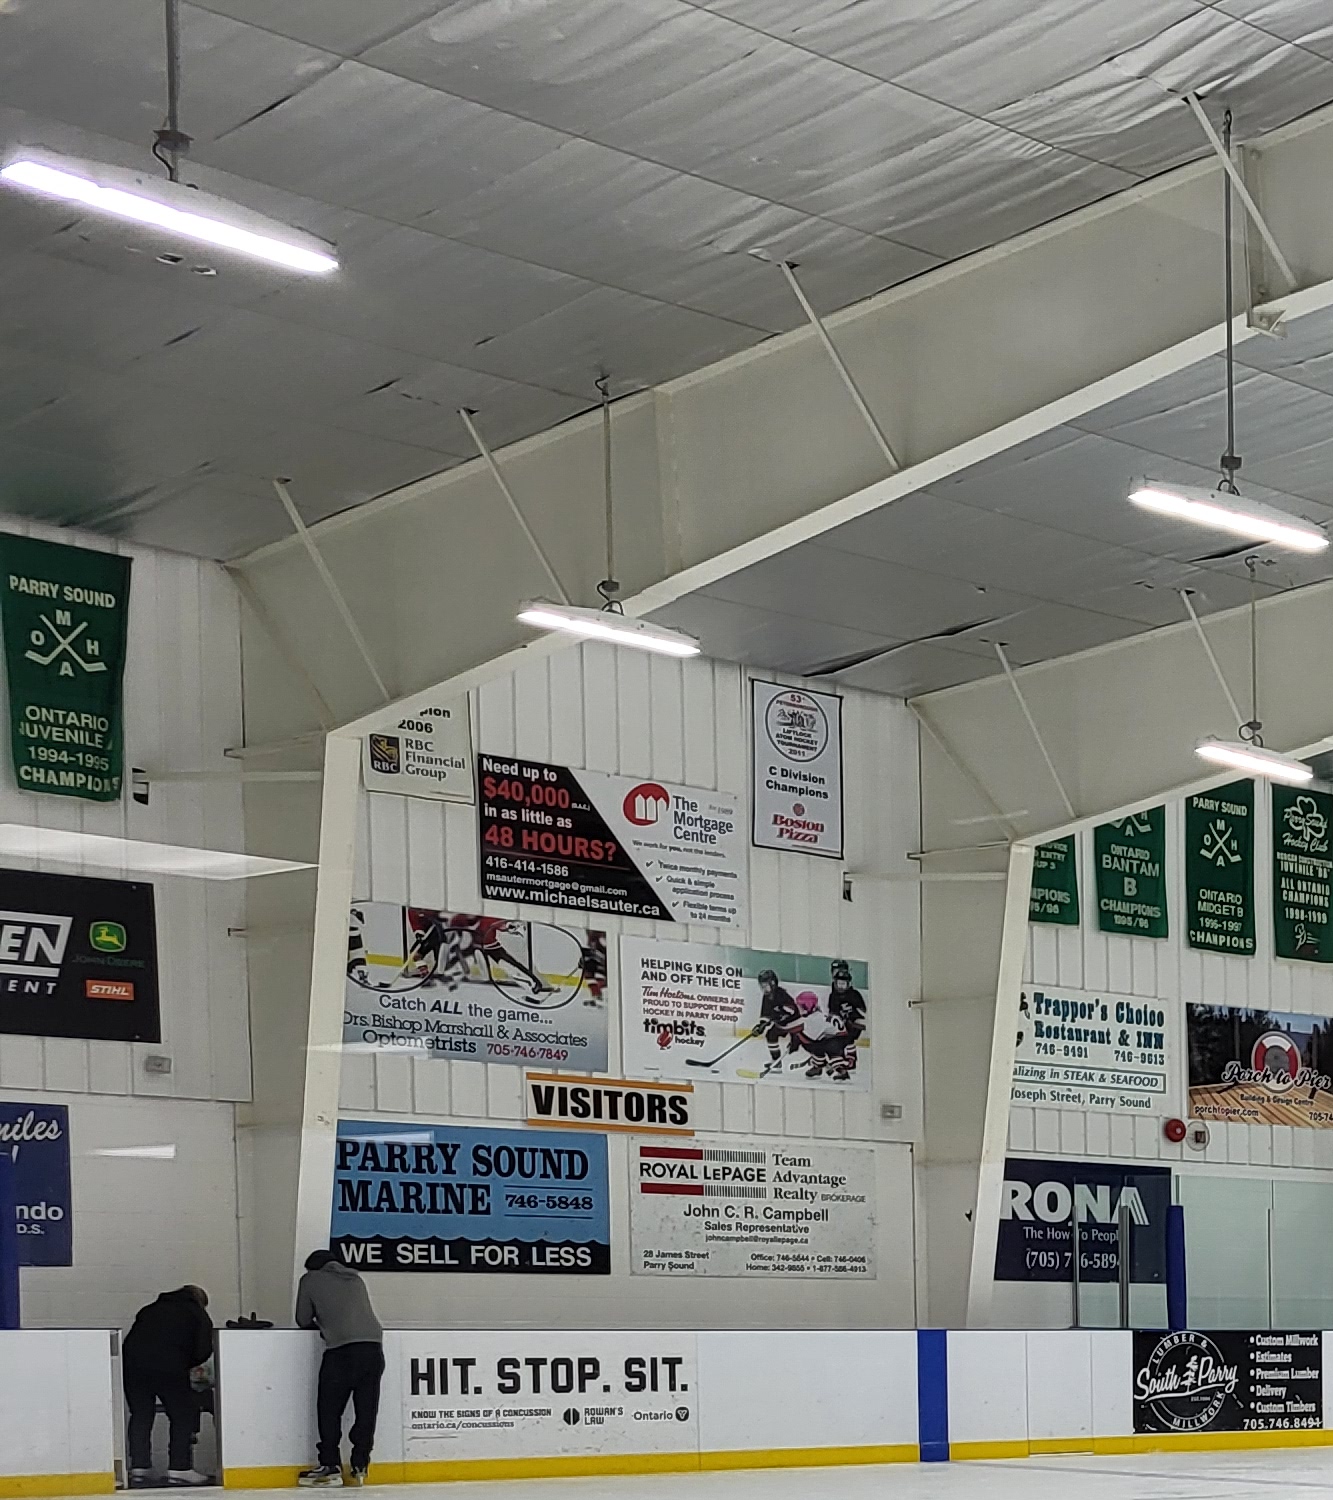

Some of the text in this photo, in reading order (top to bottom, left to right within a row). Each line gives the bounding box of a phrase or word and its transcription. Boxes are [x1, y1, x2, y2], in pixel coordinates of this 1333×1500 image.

[9, 575, 116, 608] PARRY SOUND
[25, 705, 108, 731] ONTARIO
[398, 719, 433, 733] 2006
[405, 739, 434, 752] RBC
[27, 746, 109, 771] 1994-1995
[374, 761, 397, 772] RBC
[406, 751, 465, 769] Financial
[406, 764, 446, 781] Group
[483, 758, 557, 781] Need up to
[769, 766, 825, 784] C Division
[483, 776, 569, 808] $40,000
[766, 780, 829, 799] Champions
[672, 796, 698, 812] The
[1193, 797, 1247, 816] PARRY SOUND
[484, 804, 572, 828] in as little as
[674, 811, 733, 834] Mortgage
[772, 814, 824, 832] Boston
[485, 824, 513, 847] 48
[522, 829, 616, 861] HOURS?
[674, 826, 716, 844] Centre
[776, 828, 818, 843] Pizza
[486, 856, 568, 877] 416-414-1586
[1102, 854, 1159, 877] BANTAM
[487, 873, 627, 896] msautermortgage@gmail.com
[1124, 877, 1137, 896] B
[486, 885, 660, 916] www.michaelsauter.ca
[1200, 889, 1242, 904] ONTARIO
[1283, 890, 1329, 908] CHAMPIONS
[1101, 899, 1161, 918] CHAMPIONS
[1190, 930, 1253, 948] CHAMPIONS
[641, 958, 742, 977] HELPING KIDS ON
[641, 971, 740, 989] AND OFF THE ICE
[91, 985, 129, 995] STIHL
[379, 995, 552, 1024] Catch ALL the game...
[373, 1014, 422, 1033] Bishop
[425, 1019, 493, 1038] Marshall
[497, 1025, 509, 1038] &
[514, 1029, 588, 1047] Associates
[643, 1018, 706, 1036] timbits
[1034, 1021, 1164, 1049] Restaurant & INN
[675, 1036, 704, 1047] hockey
[1050, 1069, 1059, 1078] in
[1064, 1070, 1094, 1082] STEAK
[1099, 1074, 1106, 1082] &
[1110, 1075, 1158, 1087] SEAFOOD
[1222, 1061, 1331, 1089] Porch to Pier
[531, 1085, 688, 1125] VISITORS
[1011, 1088, 1150, 1108] Joseph Street, Parry Sound
[1195, 1105, 1258, 1116] porchtopier.com
[336, 1138, 588, 1180] PARRY SOUND
[772, 1154, 811, 1168] Team
[639, 1163, 698, 1179] ROYAL
[772, 1170, 847, 1188] Advantage
[338, 1179, 593, 1215] MARINE 746-5848
[774, 1187, 818, 1203] Realty
[1000, 1180, 1149, 1225] RONA
[684, 1204, 828, 1223] John C. R. Campbell
[705, 1222, 809, 1234] Sales Representative
[340, 1244, 591, 1267] WE SELL FOR LESS
[644, 1261, 694, 1271] Parry Sound
[1256, 1334, 1318, 1346] Custom Millwork
[1256, 1352, 1292, 1362] Estimates
[410, 1357, 688, 1395] HIT. STOP. SIT.
[1134, 1357, 1238, 1400] South Parry
[1256, 1385, 1287, 1398] Delivery
[634, 1411, 673, 1420] Ontario
[1173, 1391, 1224, 1426] MILLWORK
[1256, 1402, 1315, 1412] Custom Timbers
[1243, 1418, 1321, 1429] 705.746.8491
